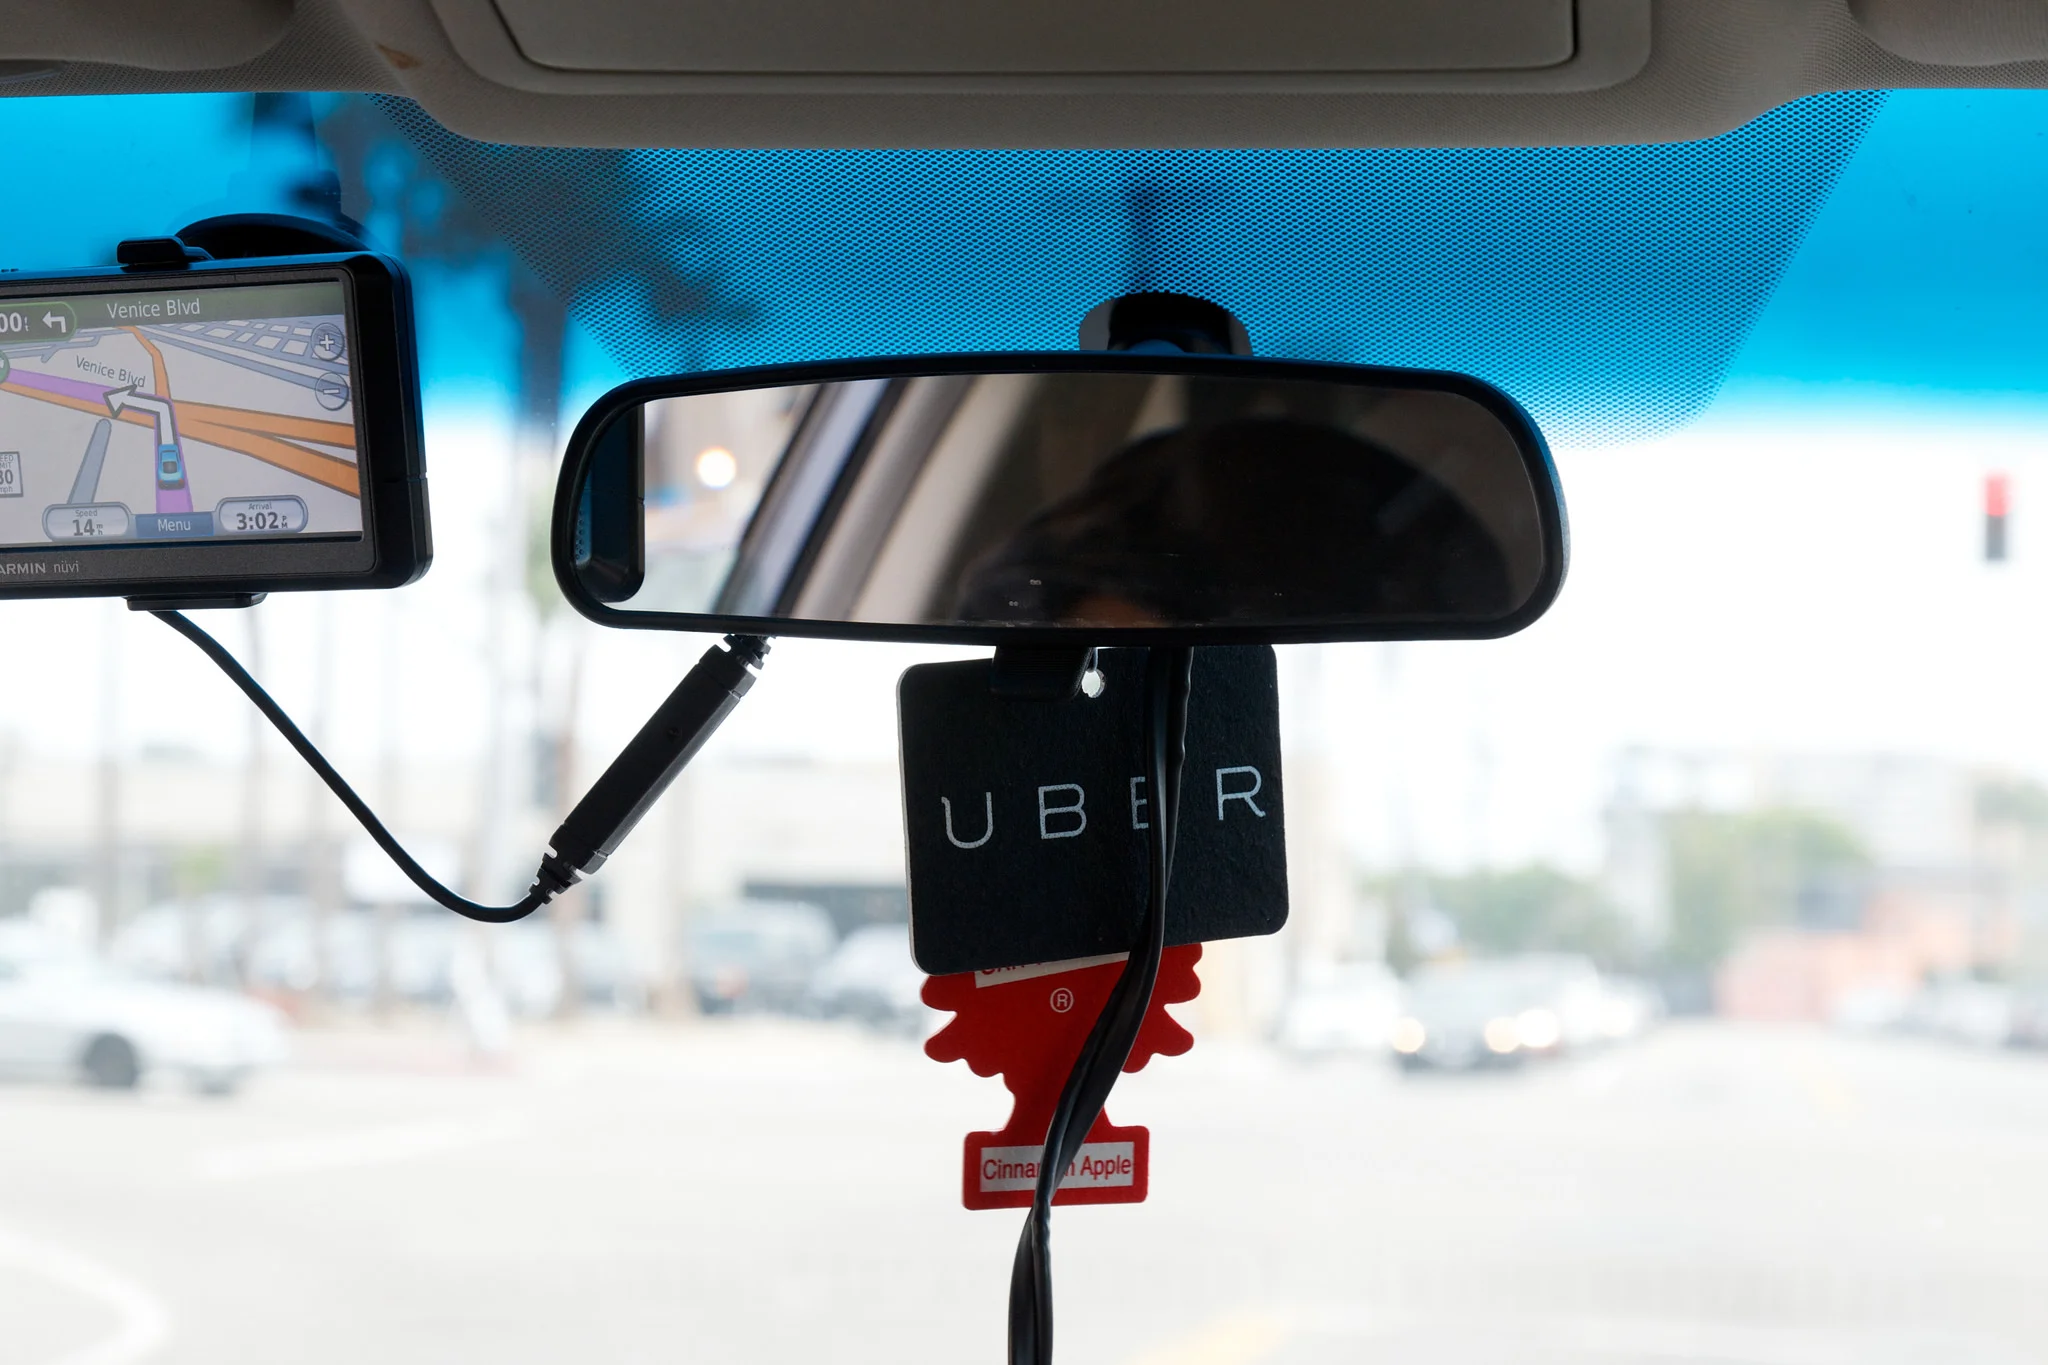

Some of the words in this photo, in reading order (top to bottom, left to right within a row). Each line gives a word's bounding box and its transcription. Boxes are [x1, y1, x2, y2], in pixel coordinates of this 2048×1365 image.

[106, 301, 161, 320] Venice
[166, 298, 201, 316] Blvd
[75, 355, 115, 379] Venice
[118, 368, 146, 388] Blvd
[75, 509, 98, 518] Speed
[248, 502, 272, 511] Arrival
[72, 518, 95, 536] 14
[157, 518, 191, 532] Menu
[236, 512, 279, 530] 3:02
[983, 1158, 1075, 1180] Cinnan
[1080, 1154, 1132, 1181] Apple
